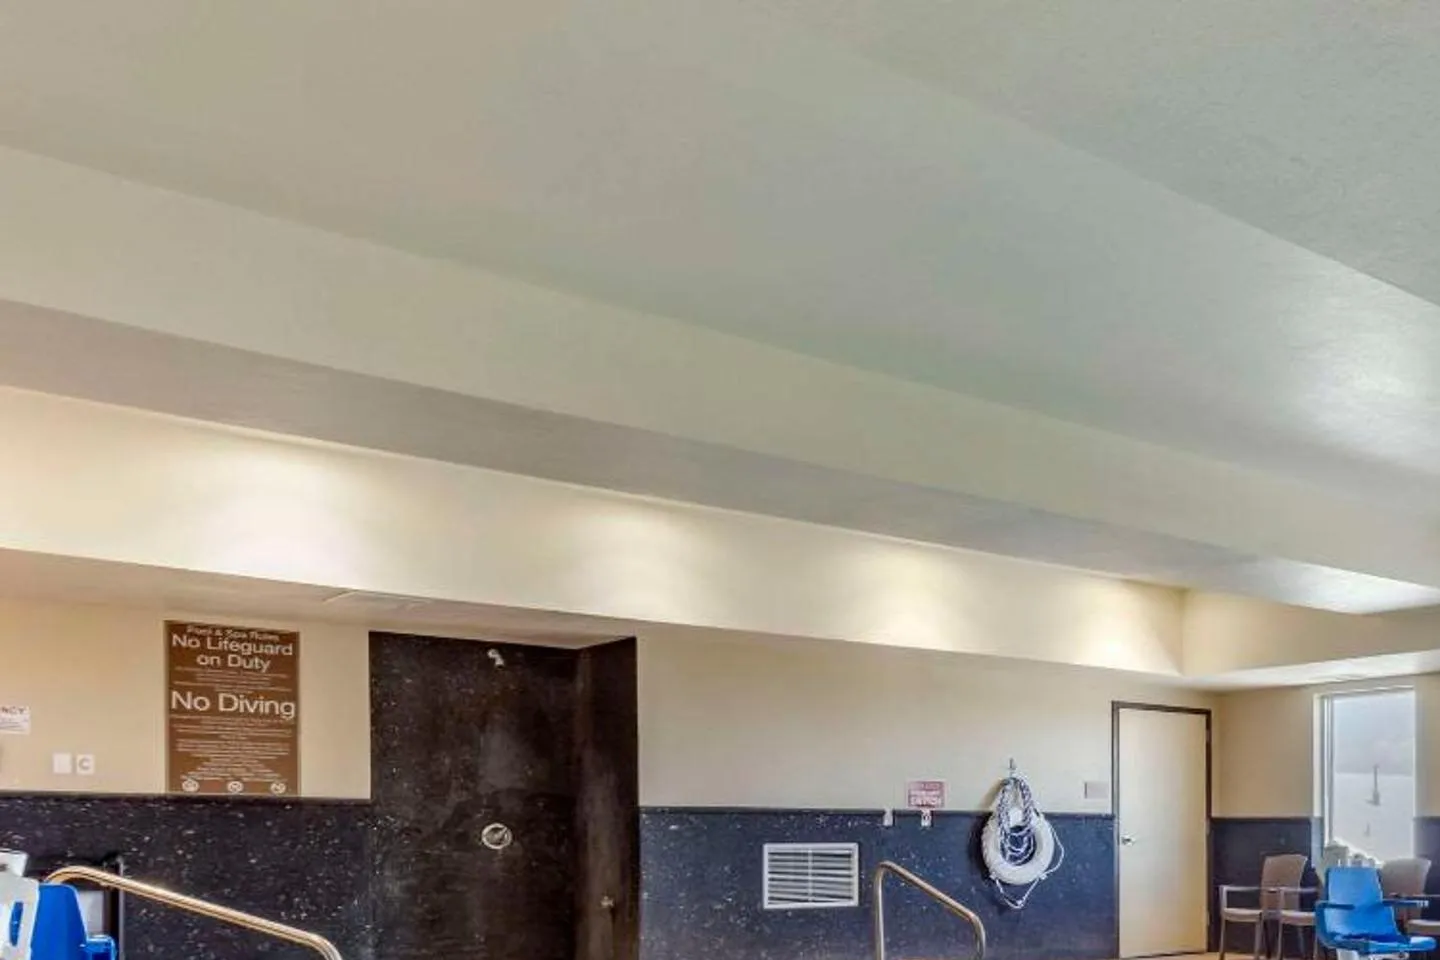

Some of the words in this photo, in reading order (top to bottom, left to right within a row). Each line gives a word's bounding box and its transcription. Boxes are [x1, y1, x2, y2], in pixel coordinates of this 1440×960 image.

[172, 633, 200, 648] No
[206, 636, 293, 656] Lifeguard
[196, 653, 220, 667] on
[228, 653, 271, 673] Duty
[171, 690, 211, 712] No
[218, 692, 296, 720] Diving
